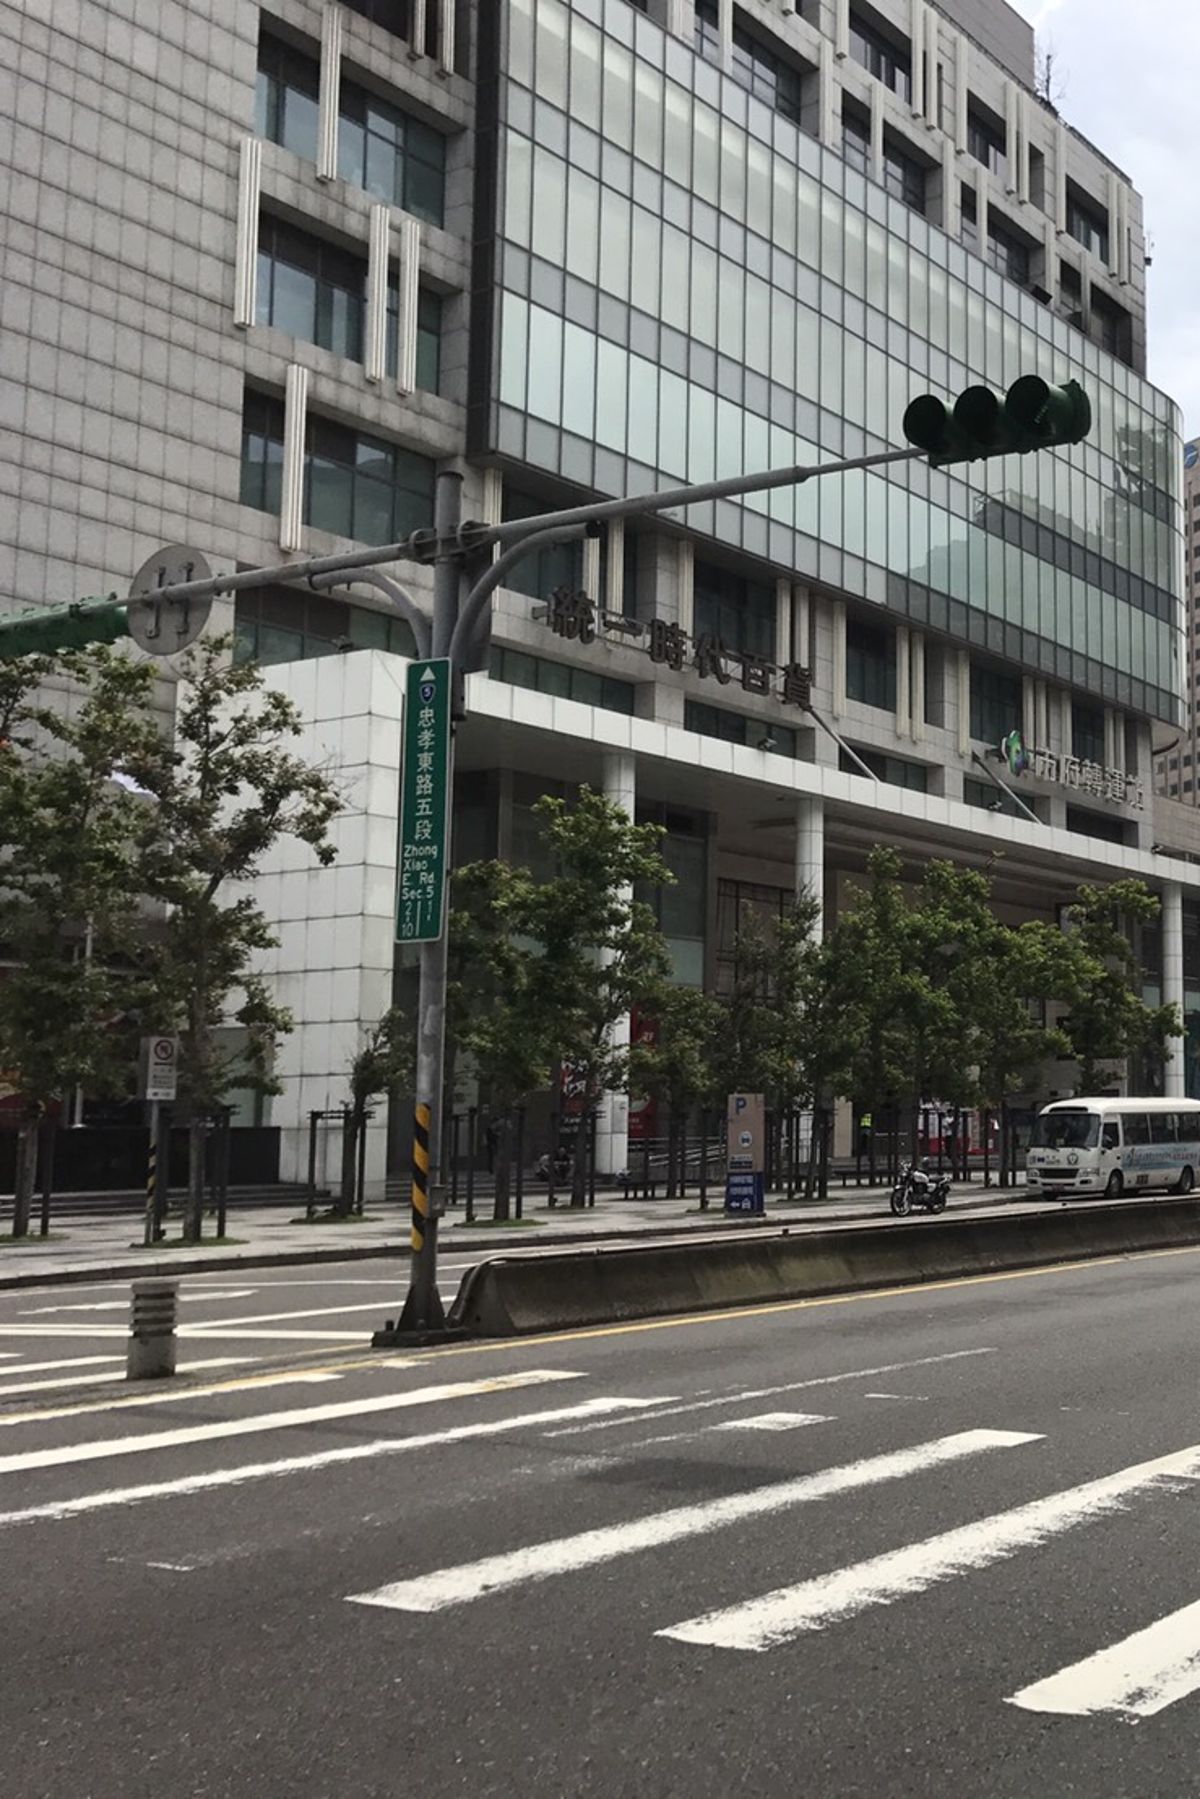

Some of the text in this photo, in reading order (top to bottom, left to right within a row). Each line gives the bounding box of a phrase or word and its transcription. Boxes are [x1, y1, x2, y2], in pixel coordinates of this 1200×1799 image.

[414, 706, 436, 841] 忠孝東路五段
[403, 844, 438, 859] Zhong
[403, 859, 428, 872] Xiao
[426, 885, 434, 899] 5
[735, 1097, 747, 1115] P
